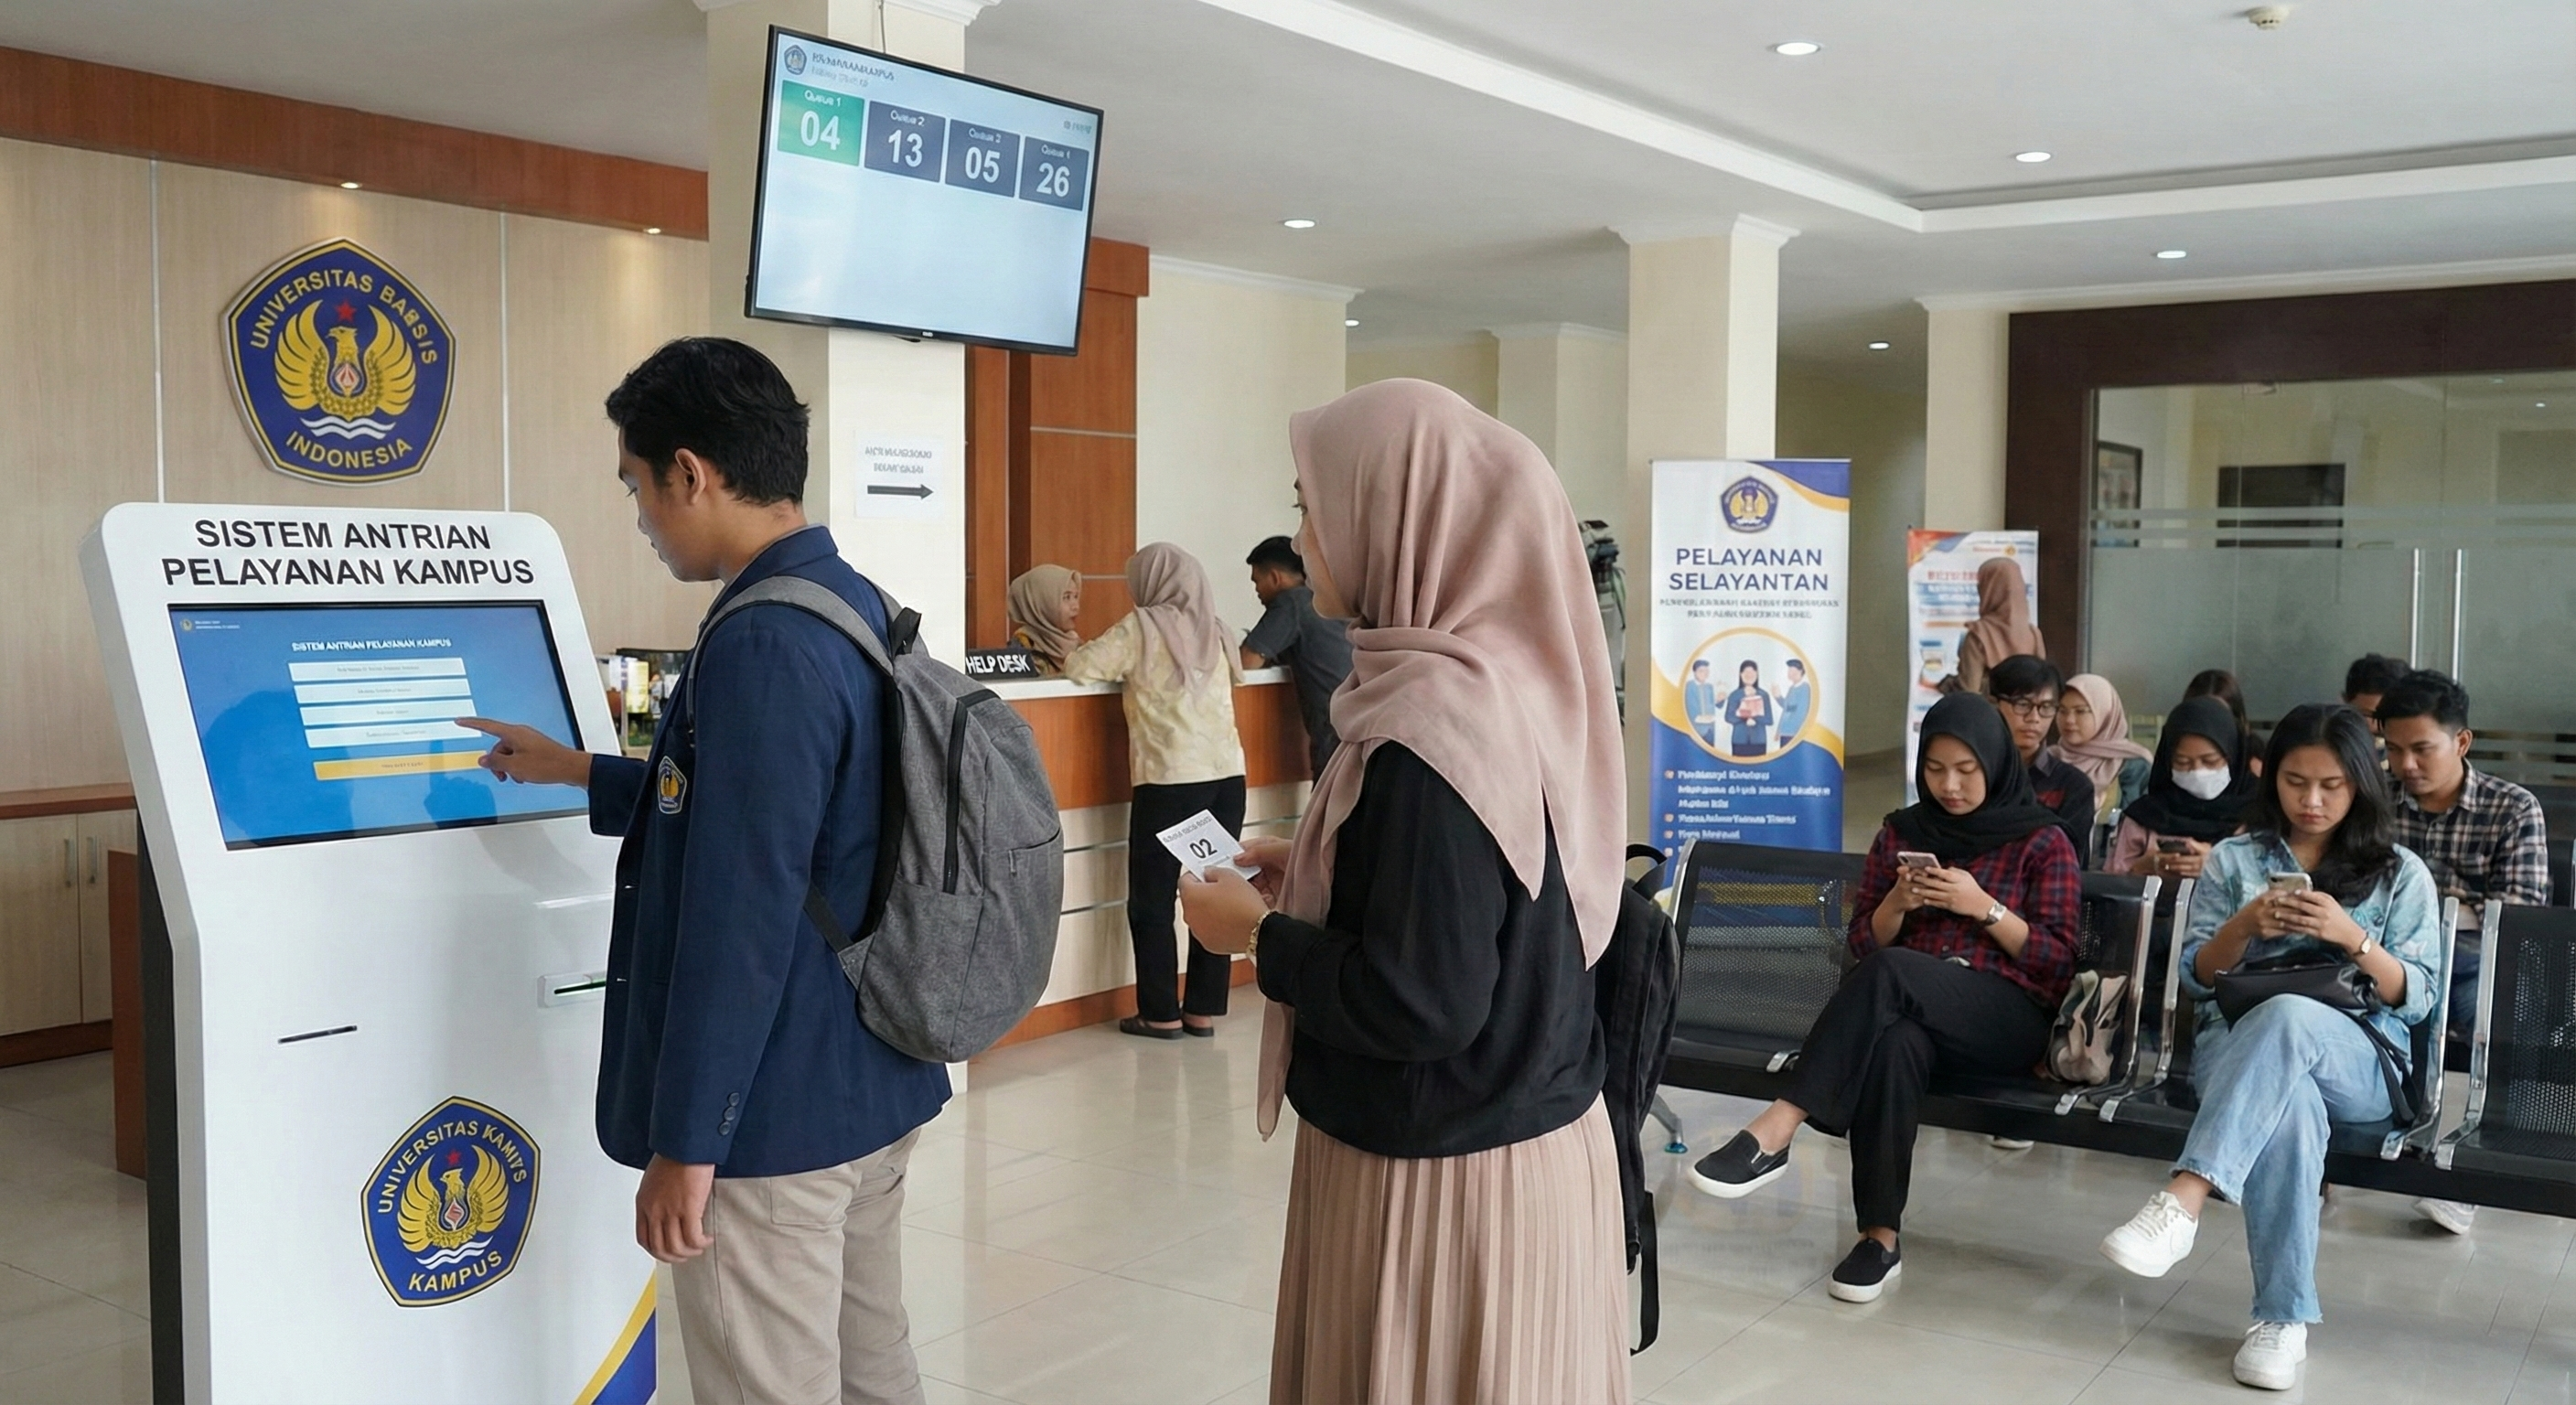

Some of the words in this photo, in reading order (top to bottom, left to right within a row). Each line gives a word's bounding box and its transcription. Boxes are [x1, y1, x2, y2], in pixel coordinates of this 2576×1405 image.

[836, 97, 842, 107] 1
[800, 111, 841, 150] 04
[887, 129, 924, 167] 13
[964, 146, 1001, 183] 05
[1036, 163, 1070, 198] 26
[250, 270, 374, 350] UNIVERSITAS
[285, 431, 413, 468] INDONESIA
[194, 520, 333, 549] SISTEM
[343, 522, 491, 550] ANTRIAN
[161, 557, 385, 586] PELAYANAN
[392, 558, 536, 585] KAMPUS
[1676, 547, 1823, 567] PELAYANAN
[1669, 573, 1829, 592] SELAYANTAN
[965, 655, 996, 674] HELP
[996, 654, 1031, 673] DESK
[1189, 838, 1218, 859] 02
[377, 1120, 478, 1214] UNIVERSITAS
[408, 1249, 503, 1292] KAMPUS
